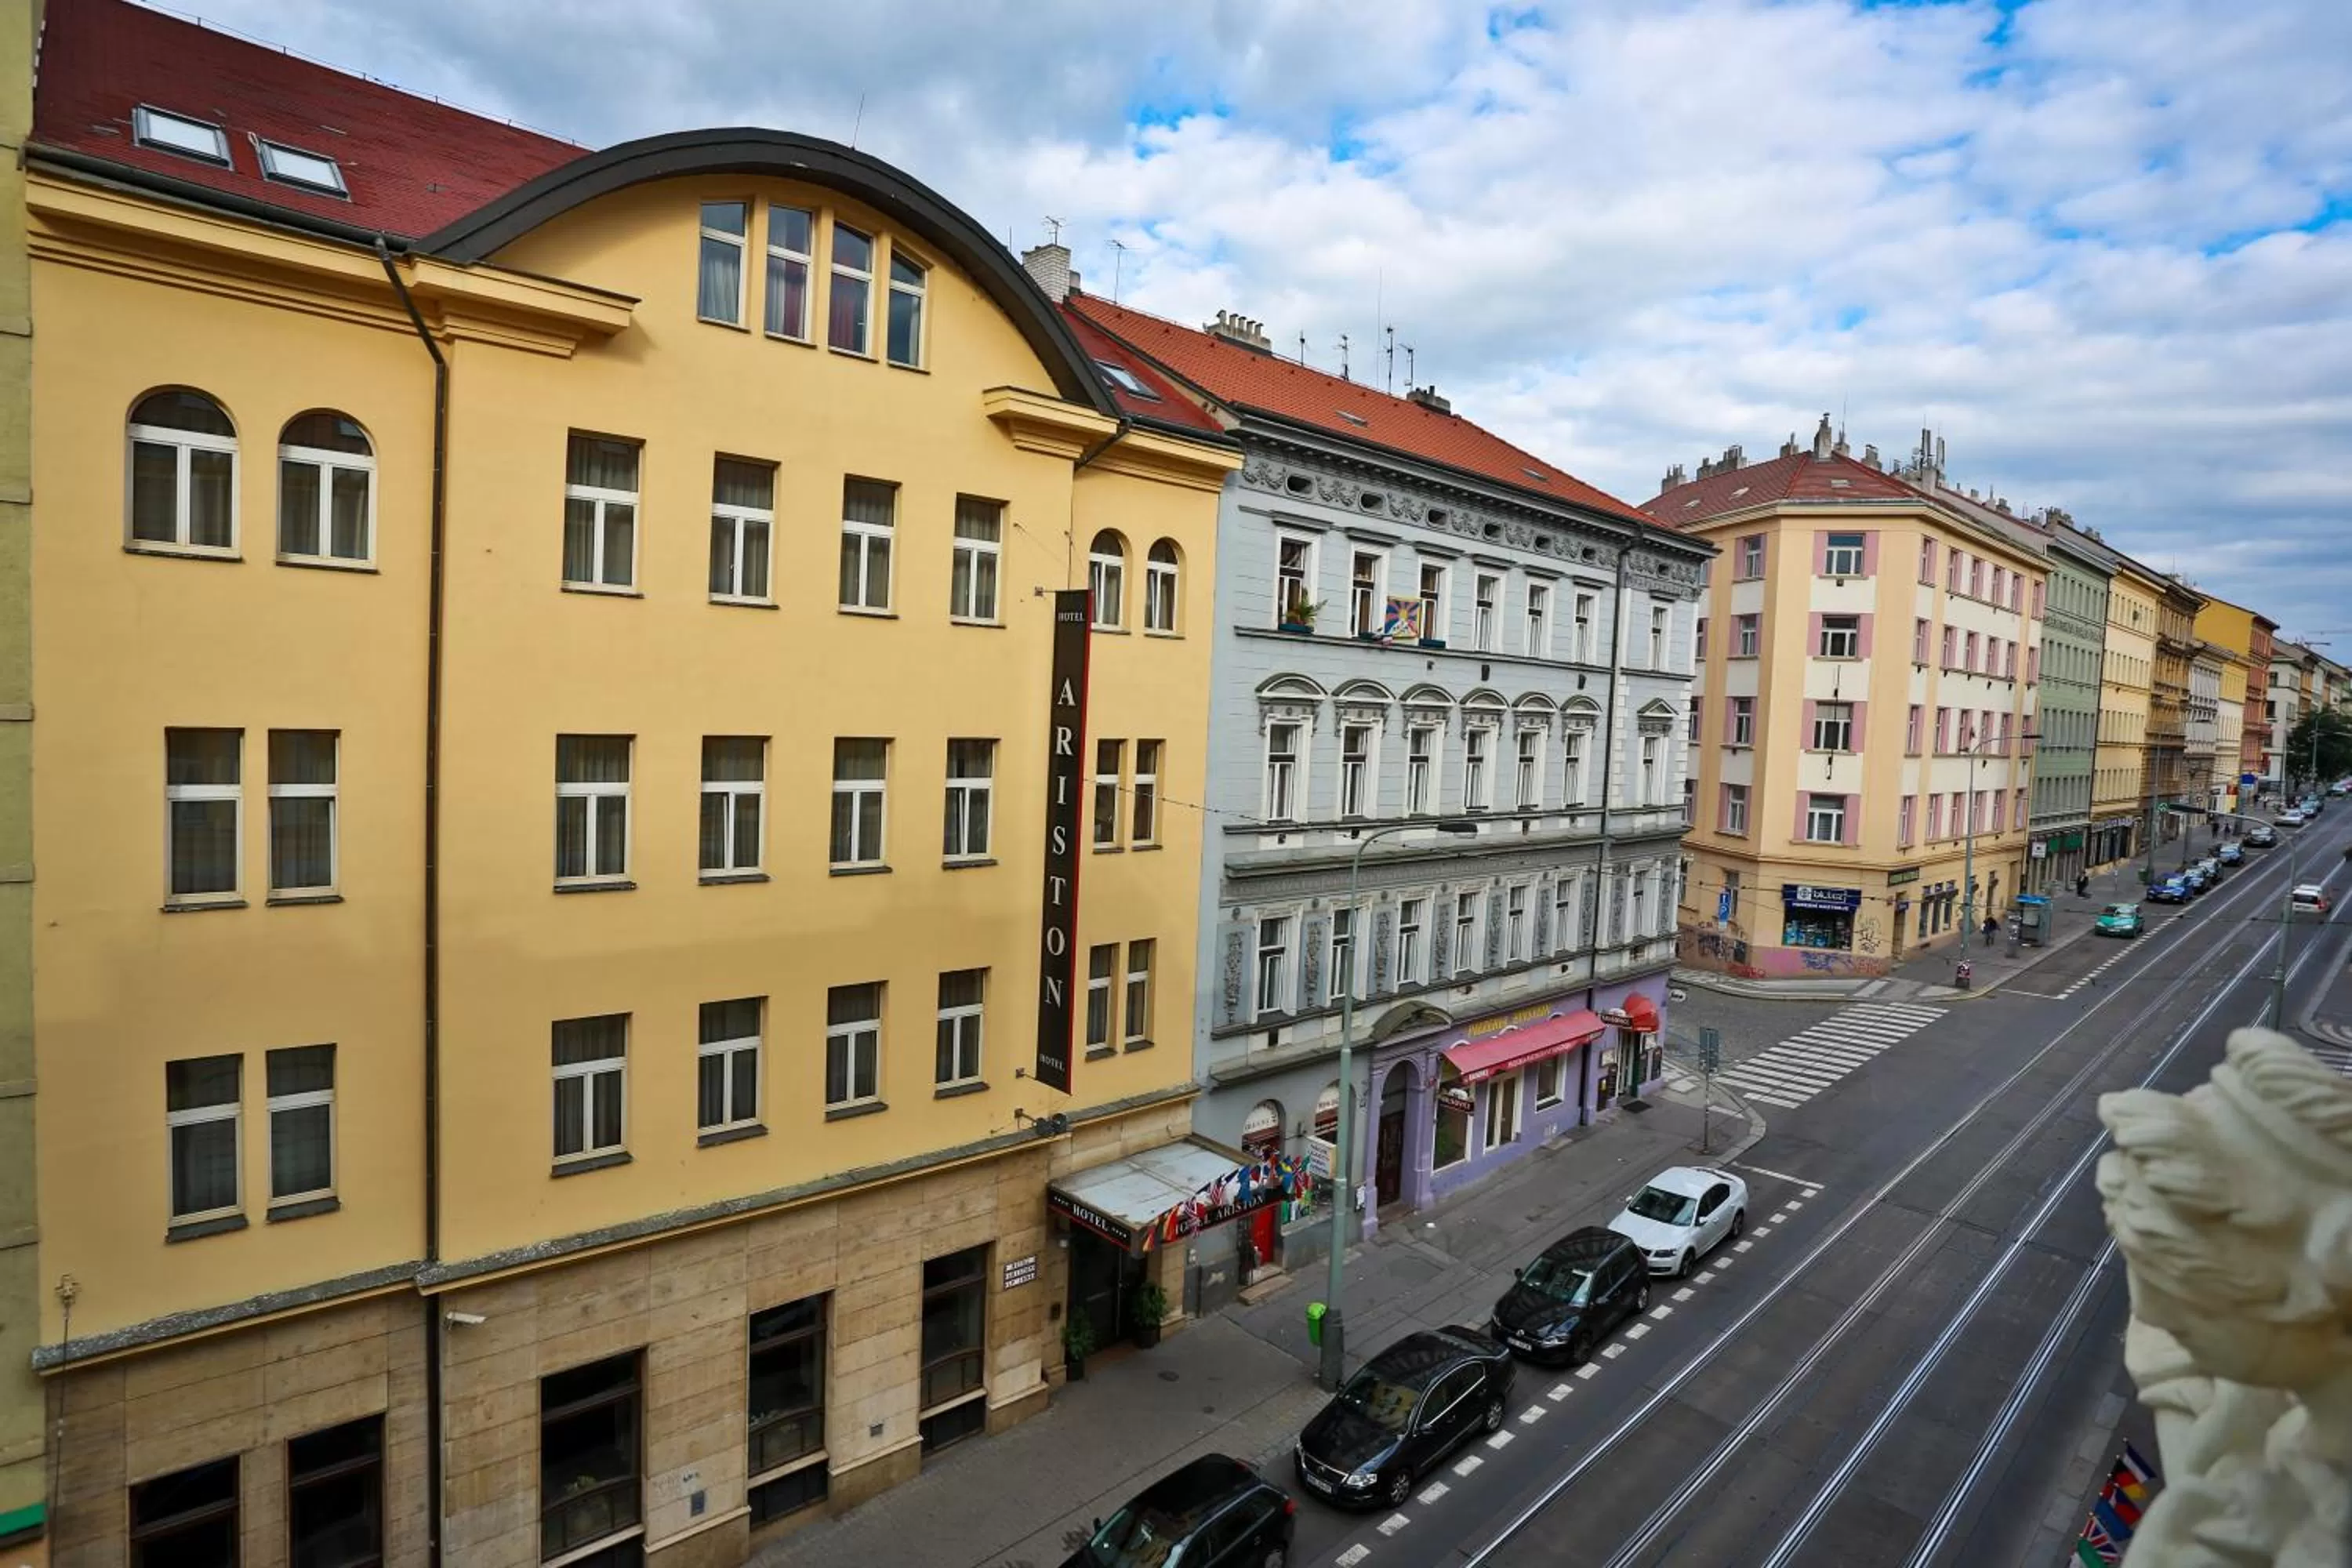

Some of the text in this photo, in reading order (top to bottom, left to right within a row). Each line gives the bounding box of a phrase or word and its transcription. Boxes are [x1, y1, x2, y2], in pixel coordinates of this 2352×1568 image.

[1058, 612, 1085, 622] HOTEL
[1044, 677, 1076, 1008] ARISTON
[1039, 1053, 1065, 1073] HOTEL
[1073, 1203, 1109, 1232] HOTEL
